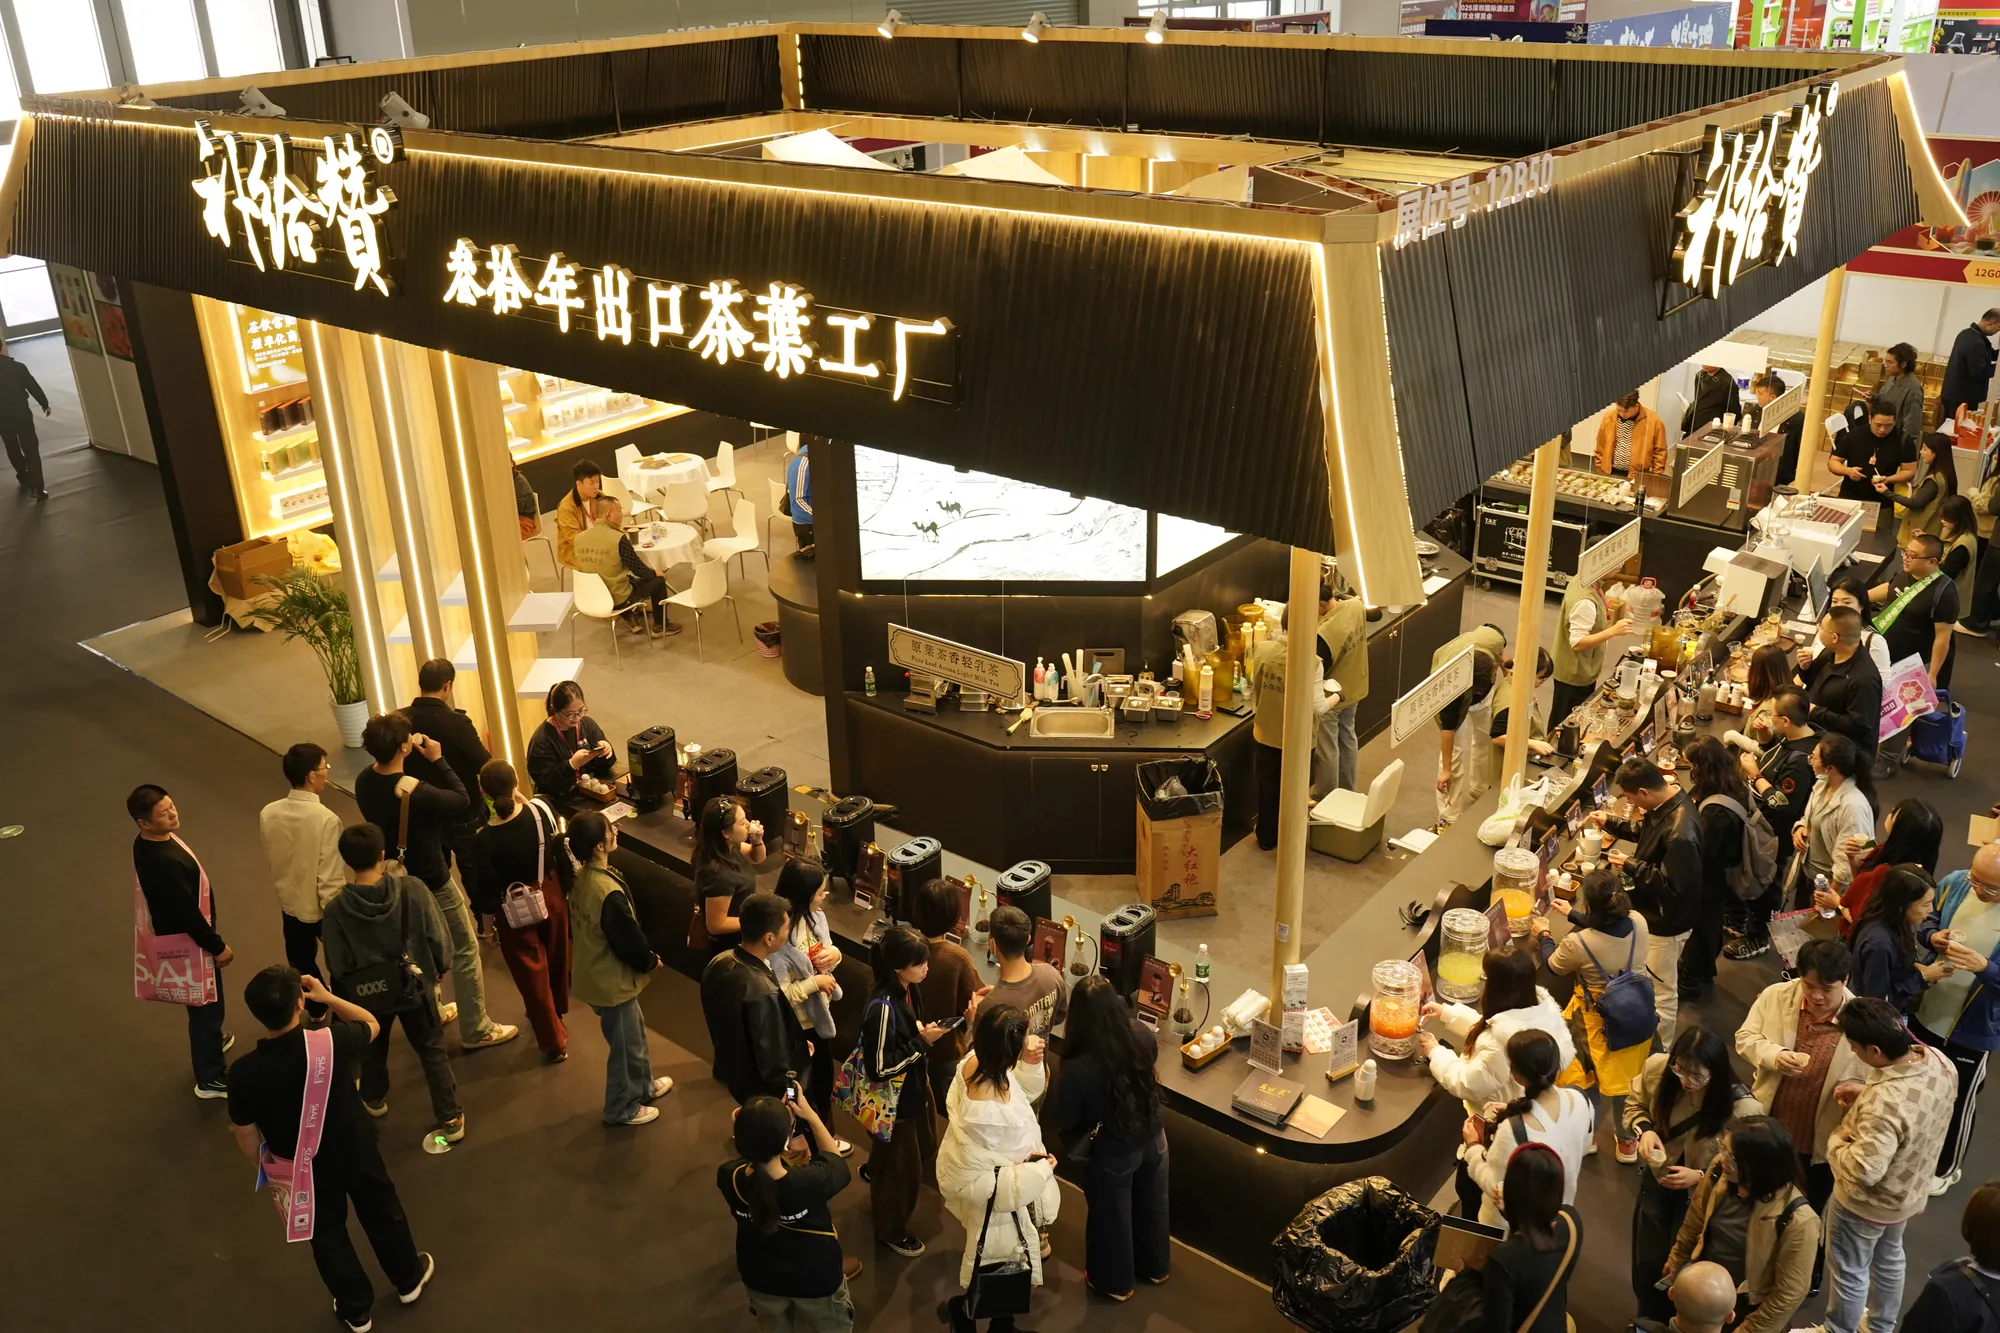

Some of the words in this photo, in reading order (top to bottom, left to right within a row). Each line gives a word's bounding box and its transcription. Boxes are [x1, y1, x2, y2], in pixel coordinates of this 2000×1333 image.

[1460, 12, 1493, 20] 饮业博览会
[1461, 4, 1515, 13] 025深圳国际酒店及
[1393, 152, 1554, 250] 展位号:12B50
[911, 639, 999, 677] 原葉茶香轻乳茶
[924, 657, 938, 669] Leaf
[1183, 845, 1199, 886] 大红袍
[156, 987, 204, 1004] 西雅展
